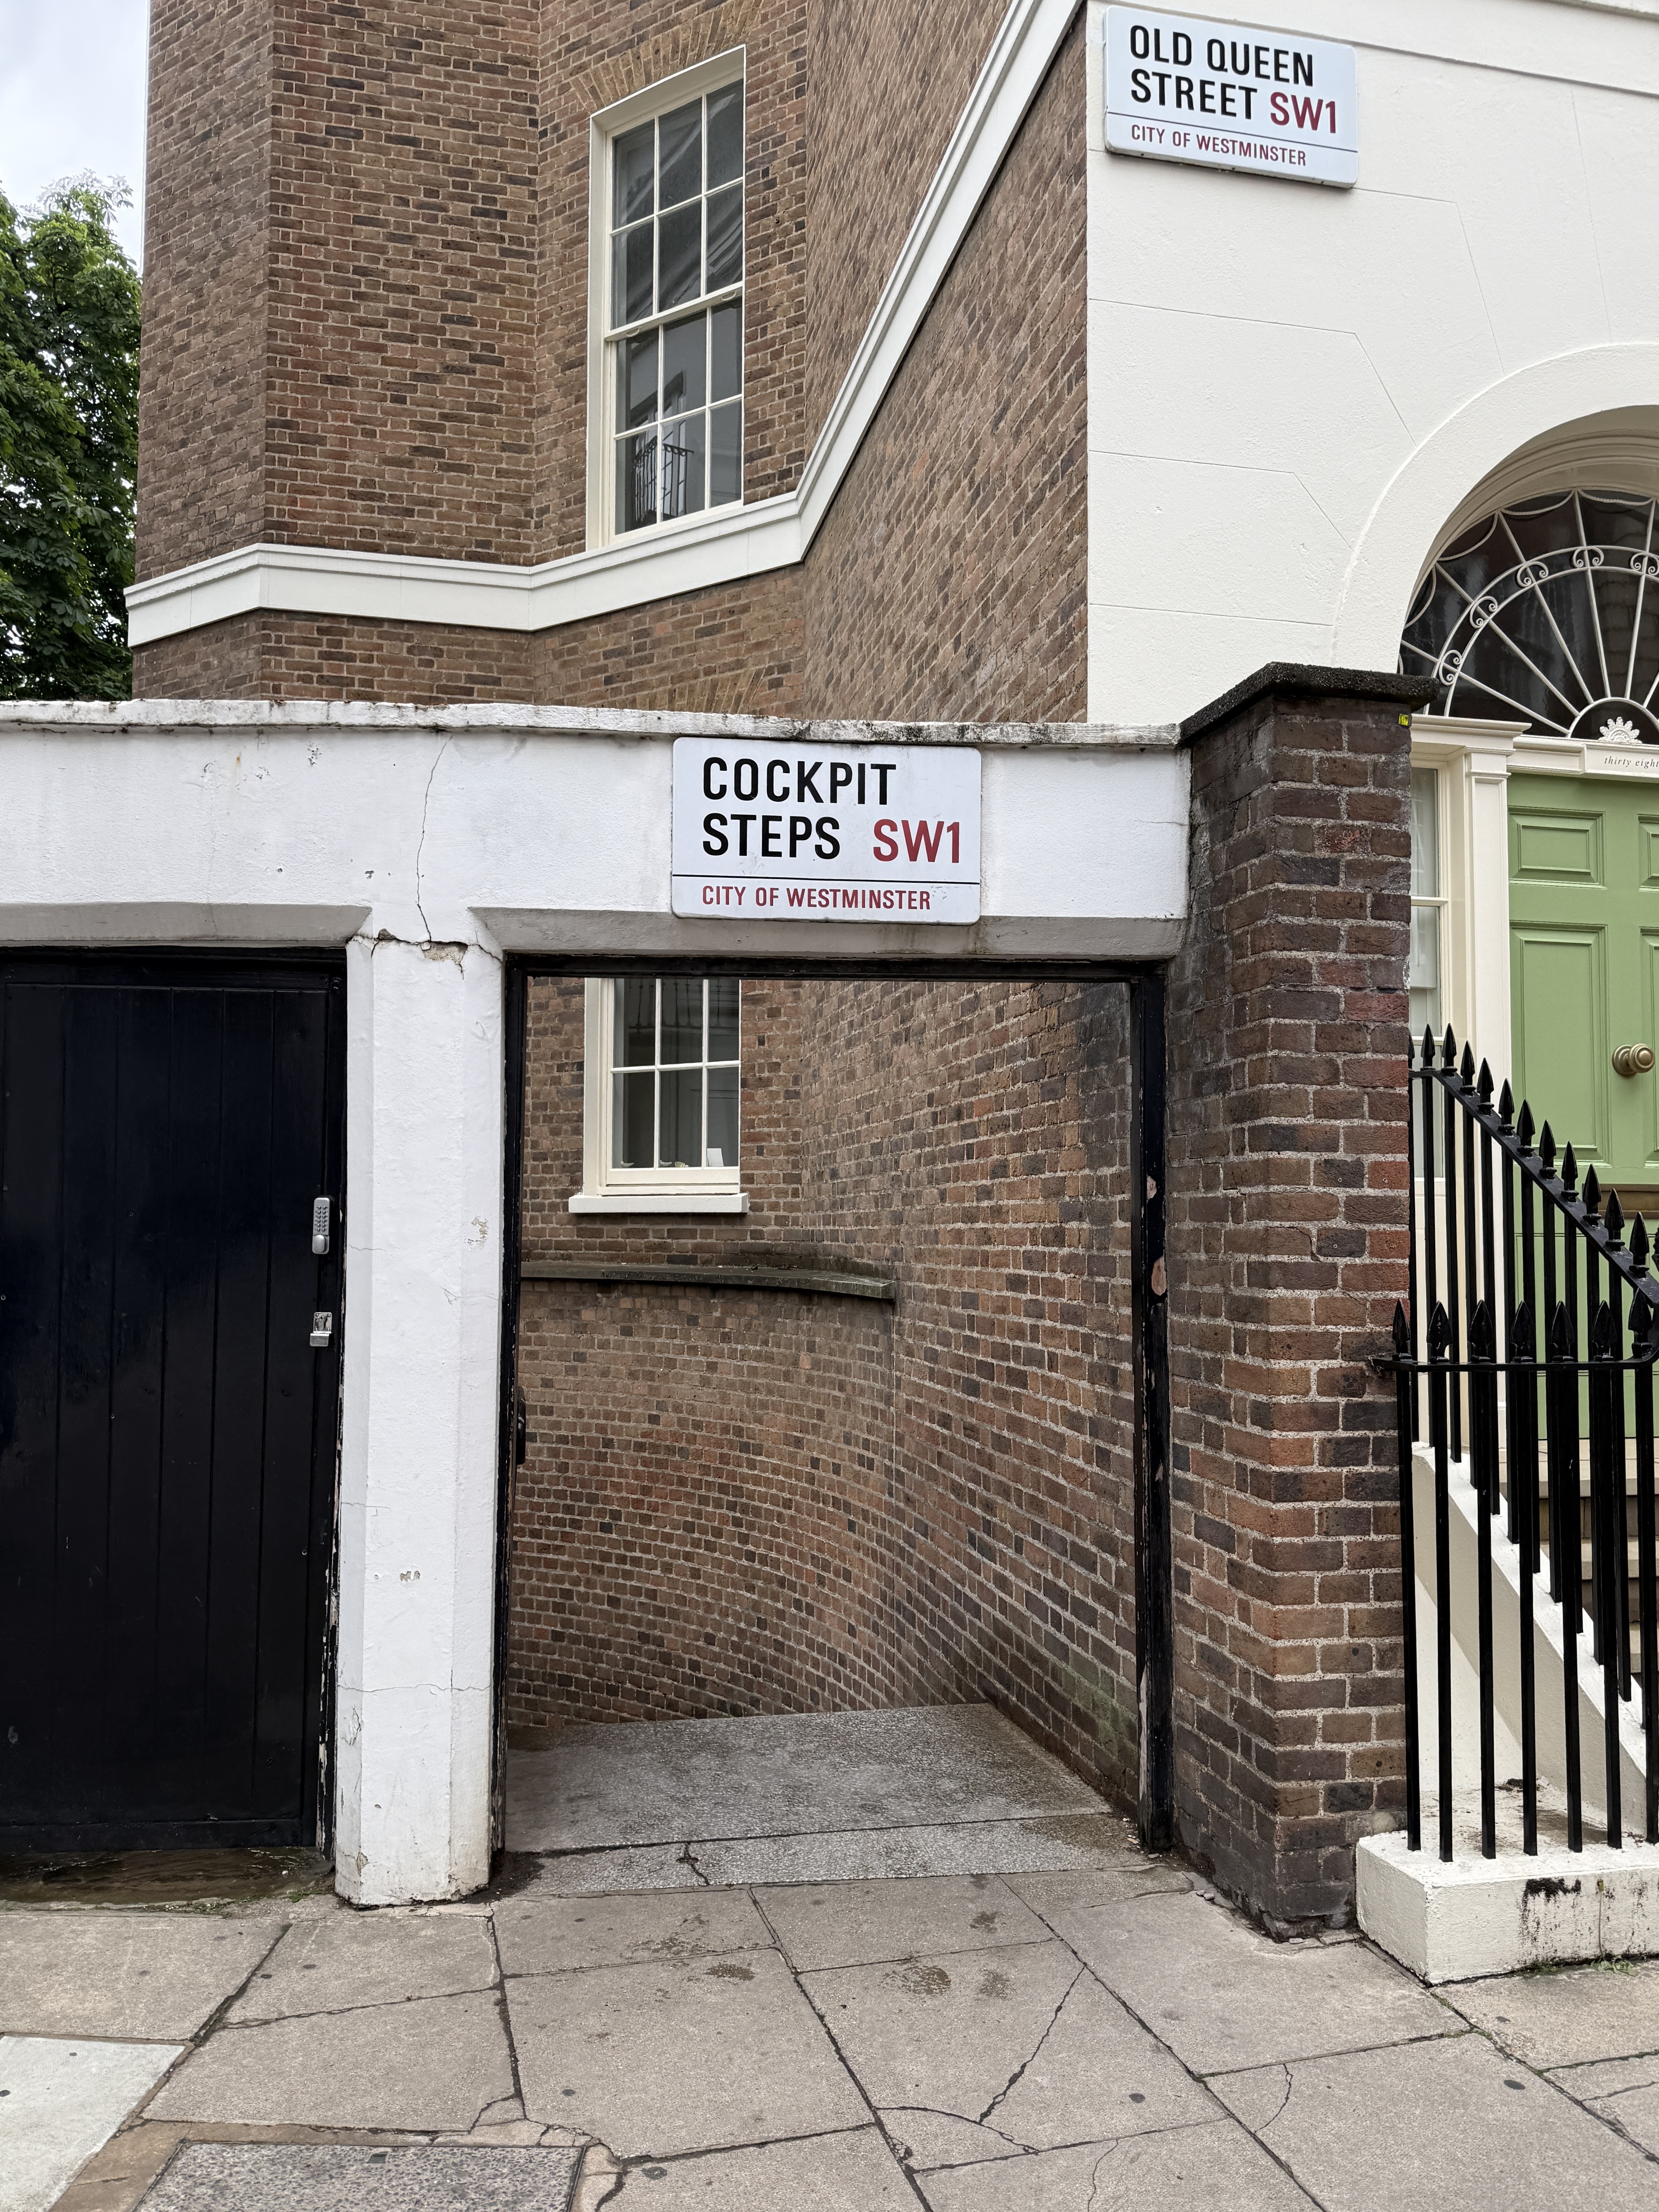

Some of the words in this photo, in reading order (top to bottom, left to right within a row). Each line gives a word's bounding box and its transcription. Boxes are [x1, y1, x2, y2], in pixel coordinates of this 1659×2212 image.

[1130, 25, 1192, 66] OLD
[1207, 38, 1313, 87] QUEEN
[1131, 68, 1258, 120] STREET
[1270, 92, 1336, 134] SW1
[1131, 124, 1165, 144] CITY
[1172, 131, 1190, 148] OF
[1197, 134, 1306, 166] WESTMINSTER
[703, 757, 896, 805] COCKPIT
[1605, 756, 1631, 767] thirty
[1635, 759, 1659, 769] eight
[703, 812, 840, 860] STEPS
[873, 819, 960, 864] SW1
[703, 885, 746, 906] CITY
[756, 887, 779, 906] OF
[786, 888, 930, 910] WESTMINSTER
